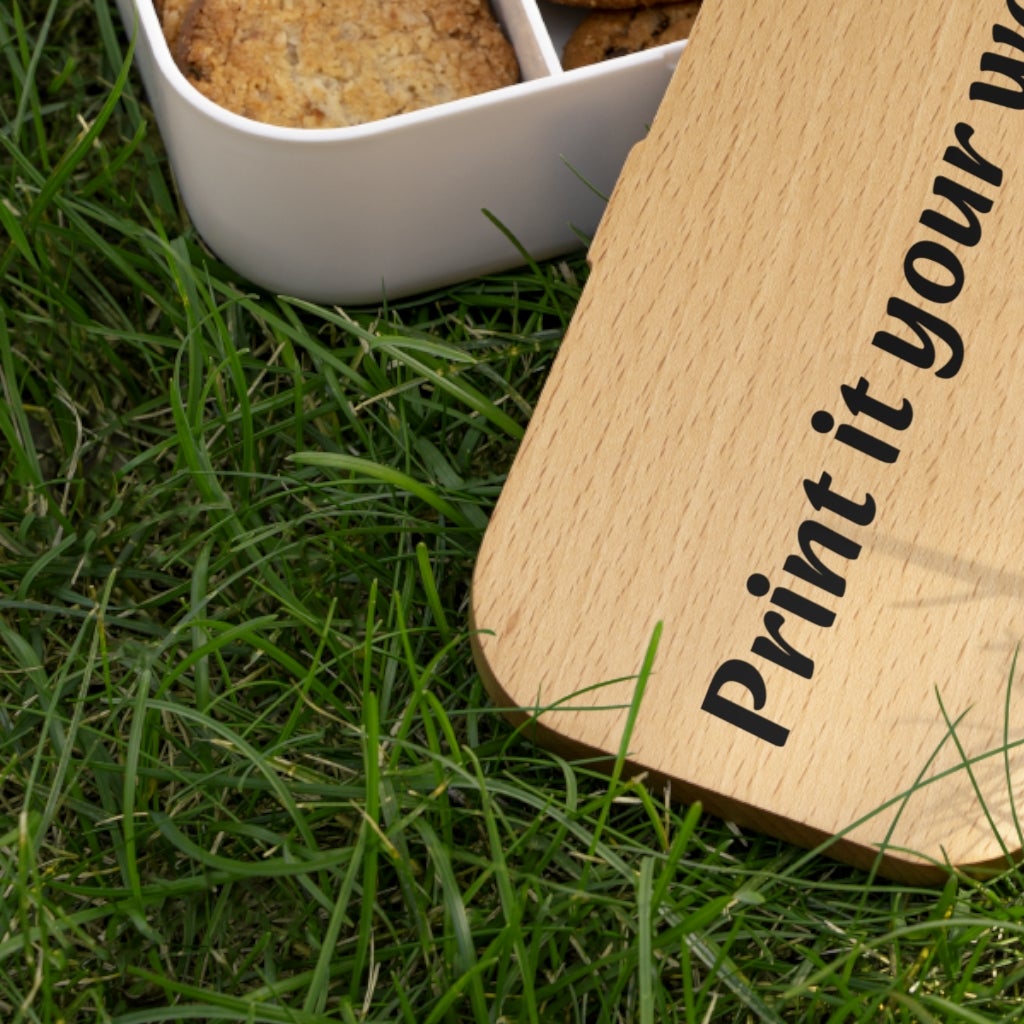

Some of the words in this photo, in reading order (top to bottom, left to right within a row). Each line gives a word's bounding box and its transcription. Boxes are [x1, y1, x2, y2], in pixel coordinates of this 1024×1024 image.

[701, 471, 876, 747] Print
[811, 377, 913, 464] it
[871, 122, 1004, 379] your
